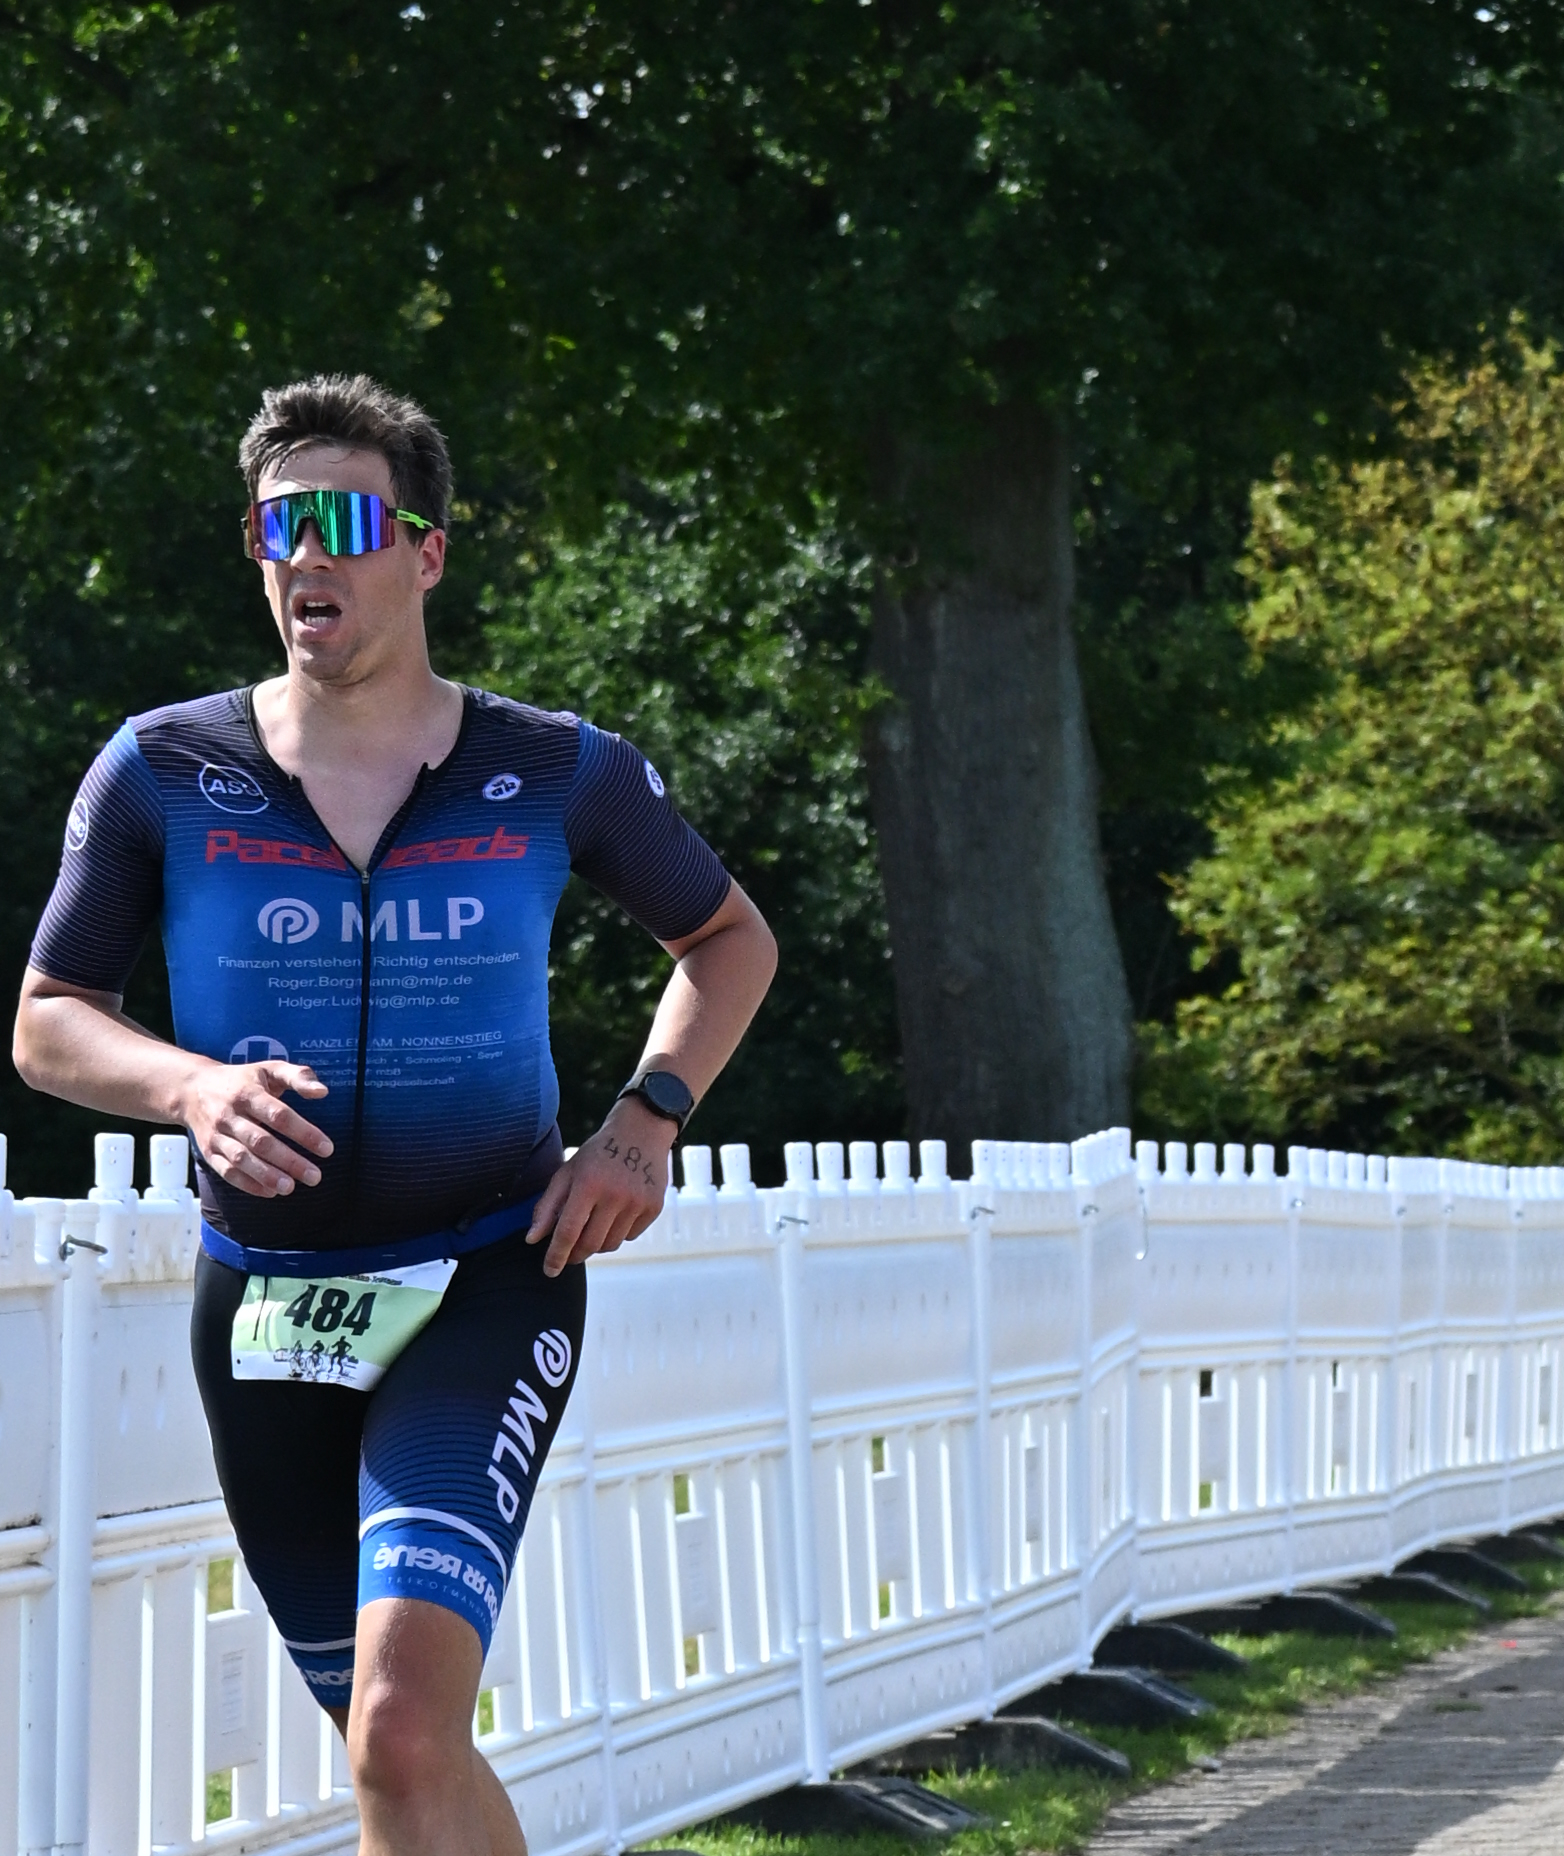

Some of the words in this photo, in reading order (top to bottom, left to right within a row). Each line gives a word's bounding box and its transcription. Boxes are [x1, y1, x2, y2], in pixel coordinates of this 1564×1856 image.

[340, 896, 485, 943] MLP
[217, 955, 280, 969] Finanzen
[373, 954, 429, 971] Richtig
[372, 1037, 393, 1048] AM
[401, 1031, 503, 1048] NONNENSTIEG
[283, 1283, 378, 1337] 484
[486, 1377, 549, 1525] MLP
